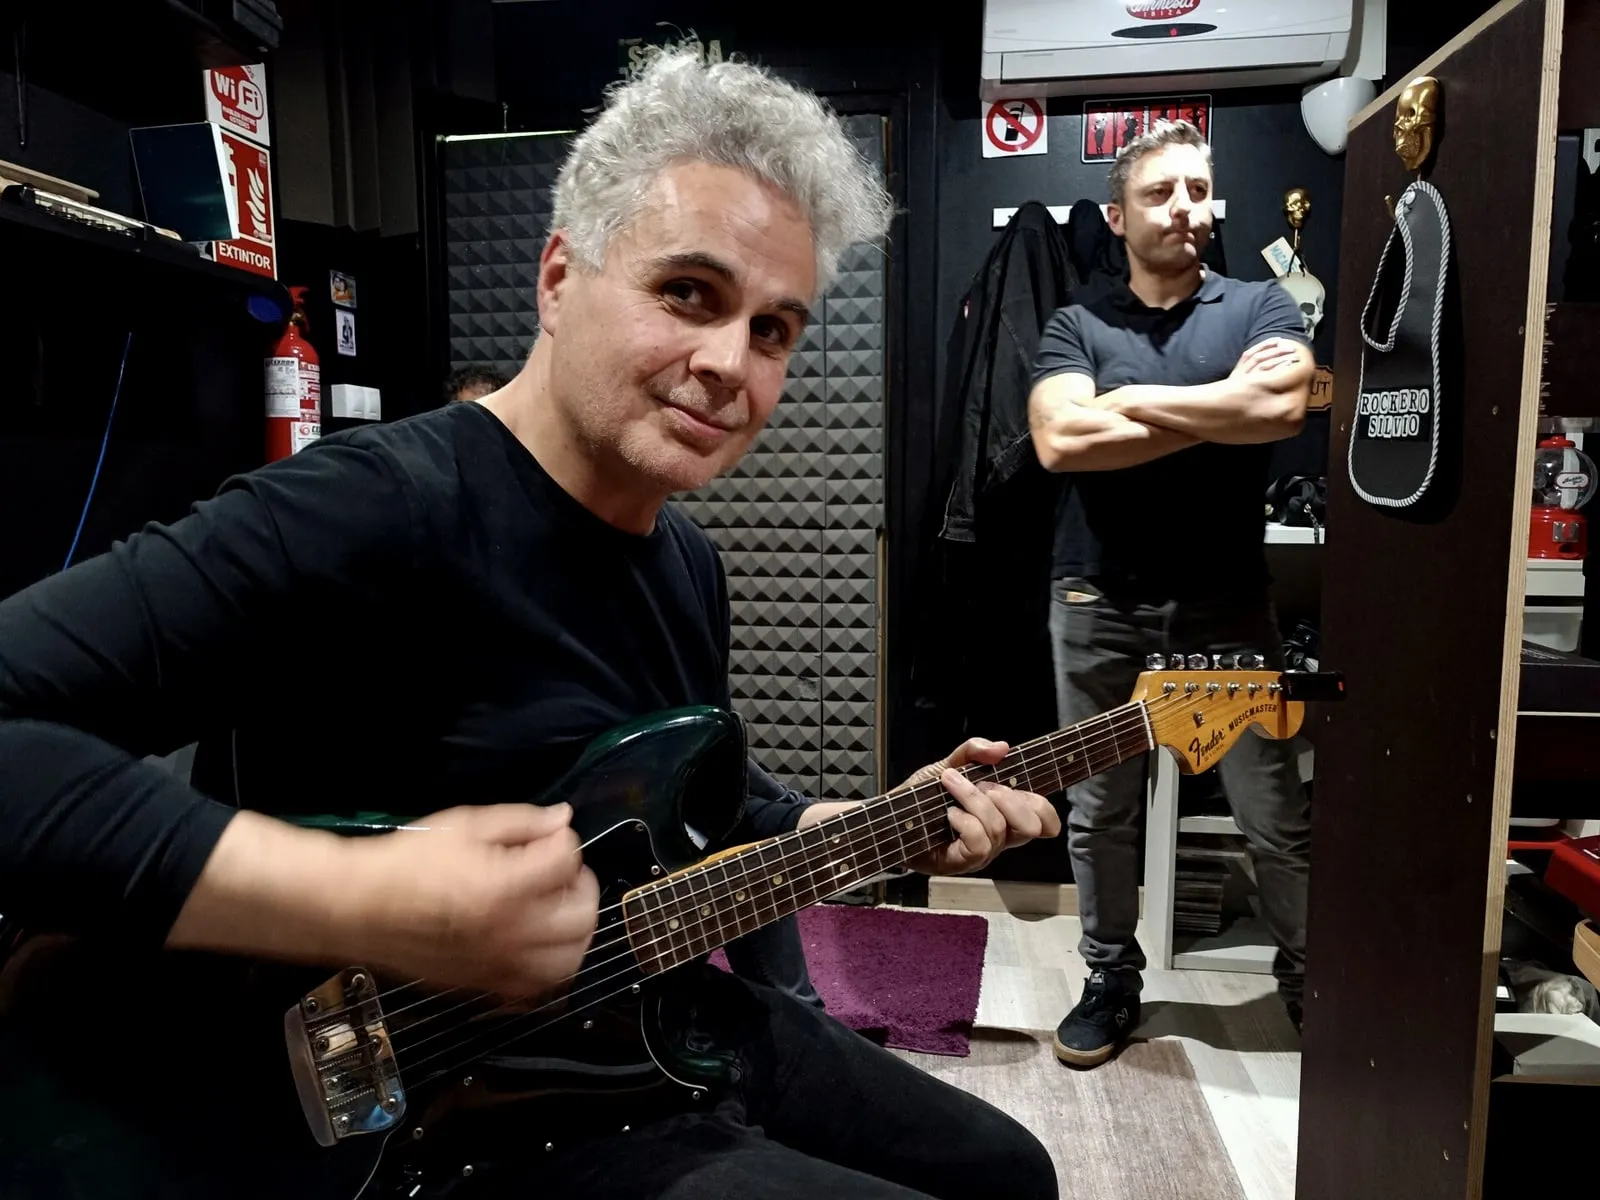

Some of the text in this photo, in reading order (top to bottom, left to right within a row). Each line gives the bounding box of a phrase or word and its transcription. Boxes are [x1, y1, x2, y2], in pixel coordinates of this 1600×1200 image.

[1143, 9, 1182, 18] IBIZA
[219, 242, 271, 270] EXTINTOR
[1311, 379, 1330, 397] UT
[1360, 389, 1429, 415] ROCKERO
[1368, 414, 1420, 438] SILVIO
[1228, 703, 1277, 732] MUSICMASTER
[1188, 729, 1226, 768] Fender
